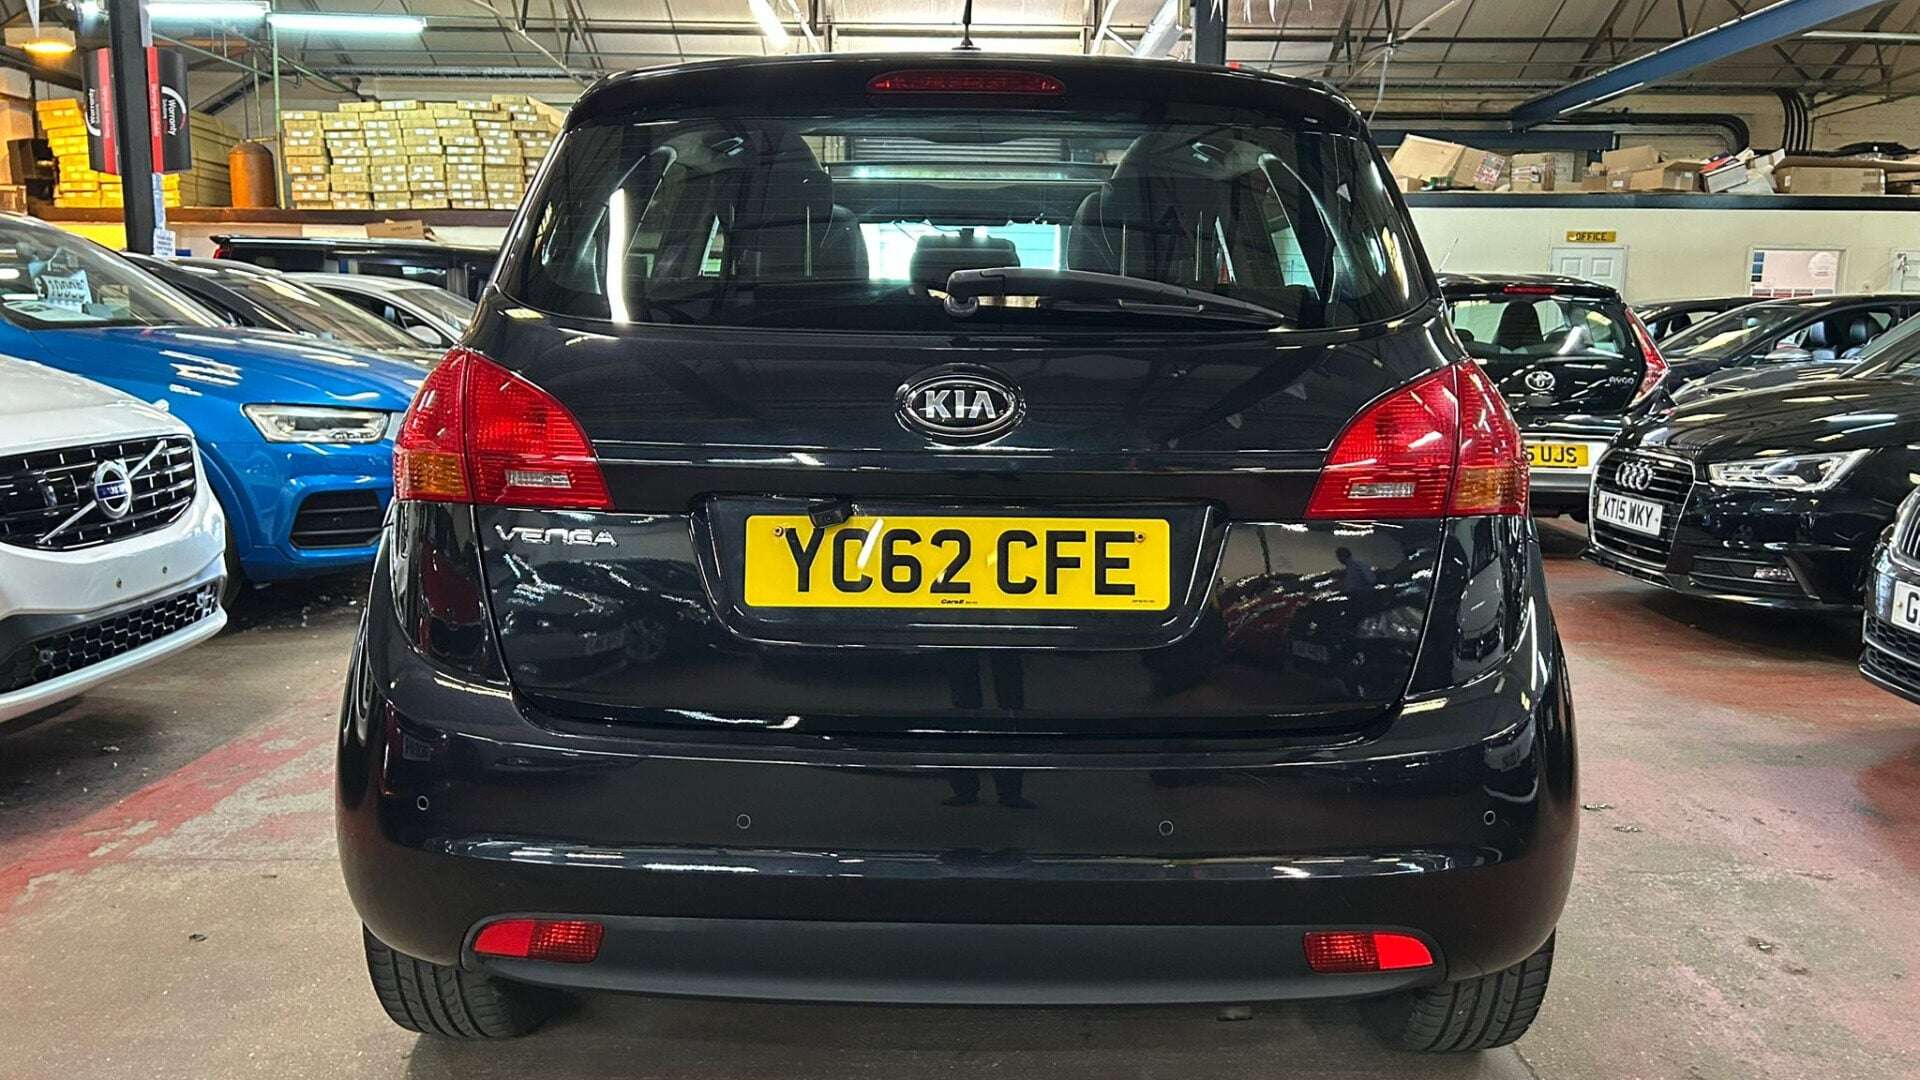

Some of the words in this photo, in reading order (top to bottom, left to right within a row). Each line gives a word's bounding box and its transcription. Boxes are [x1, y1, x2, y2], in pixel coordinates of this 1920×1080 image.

[1575, 231, 1608, 241] OFFICE
[924, 389, 997, 419] KIA
[1540, 445, 1578, 464] UJS
[1602, 495, 1627, 521] KT15
[1628, 502, 1654, 528] WKY
[494, 524, 618, 547] VENGA
[784, 527, 971, 594] YC62
[996, 529, 1136, 596] CFE
